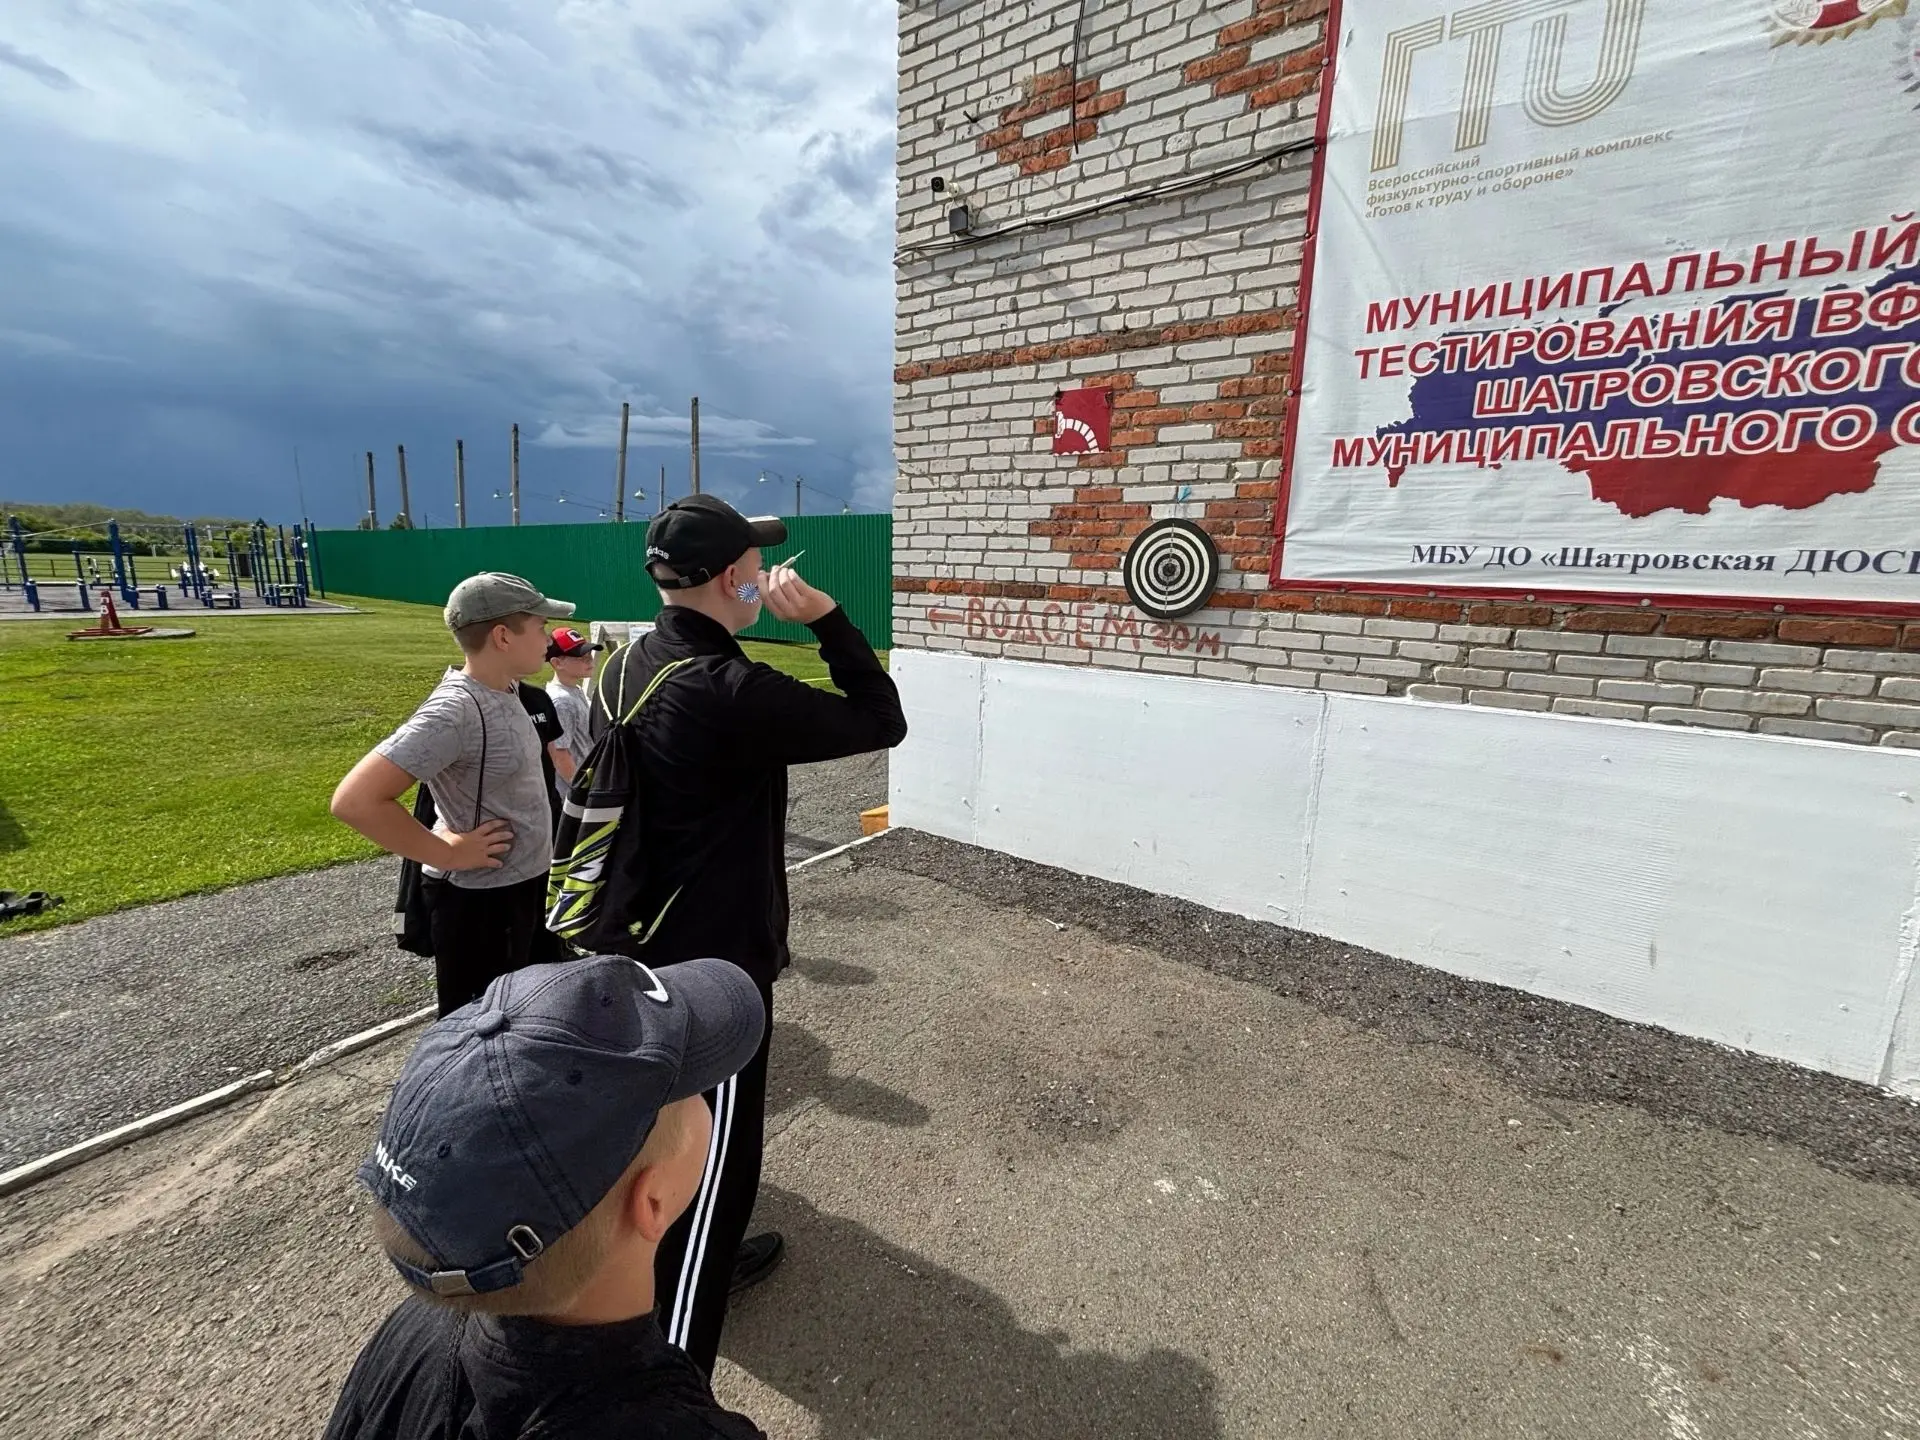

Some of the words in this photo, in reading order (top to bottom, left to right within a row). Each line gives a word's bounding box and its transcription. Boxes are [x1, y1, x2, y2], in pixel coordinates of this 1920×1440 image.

[1365, 201, 1411, 219] «Готов
[1415, 198, 1424, 210] к
[1427, 187, 1473, 207] труду
[1476, 185, 1487, 196] и
[1491, 166, 1574, 192] обороне»
[1366, 148, 1579, 207] физкультурно-спортивный
[1583, 129, 1675, 158] комплекс
[1367, 154, 1480, 192] Всероссийский
[1365, 211, 1920, 335] МУНИЦИПАЛЬНЫЙ
[1354, 298, 1796, 380] ТЕСТИРОВАНИЯ
[1474, 345, 1920, 417] ШАТРОВСКОГ
[1331, 406, 1873, 469] МУНИЦИПАЛЬНОГО
[1410, 544, 1480, 565] МБУ
[1483, 546, 1532, 569] ДО
[1540, 547, 1776, 575] «Шатровская
[967, 597, 1141, 650] ВОДОЕМ
